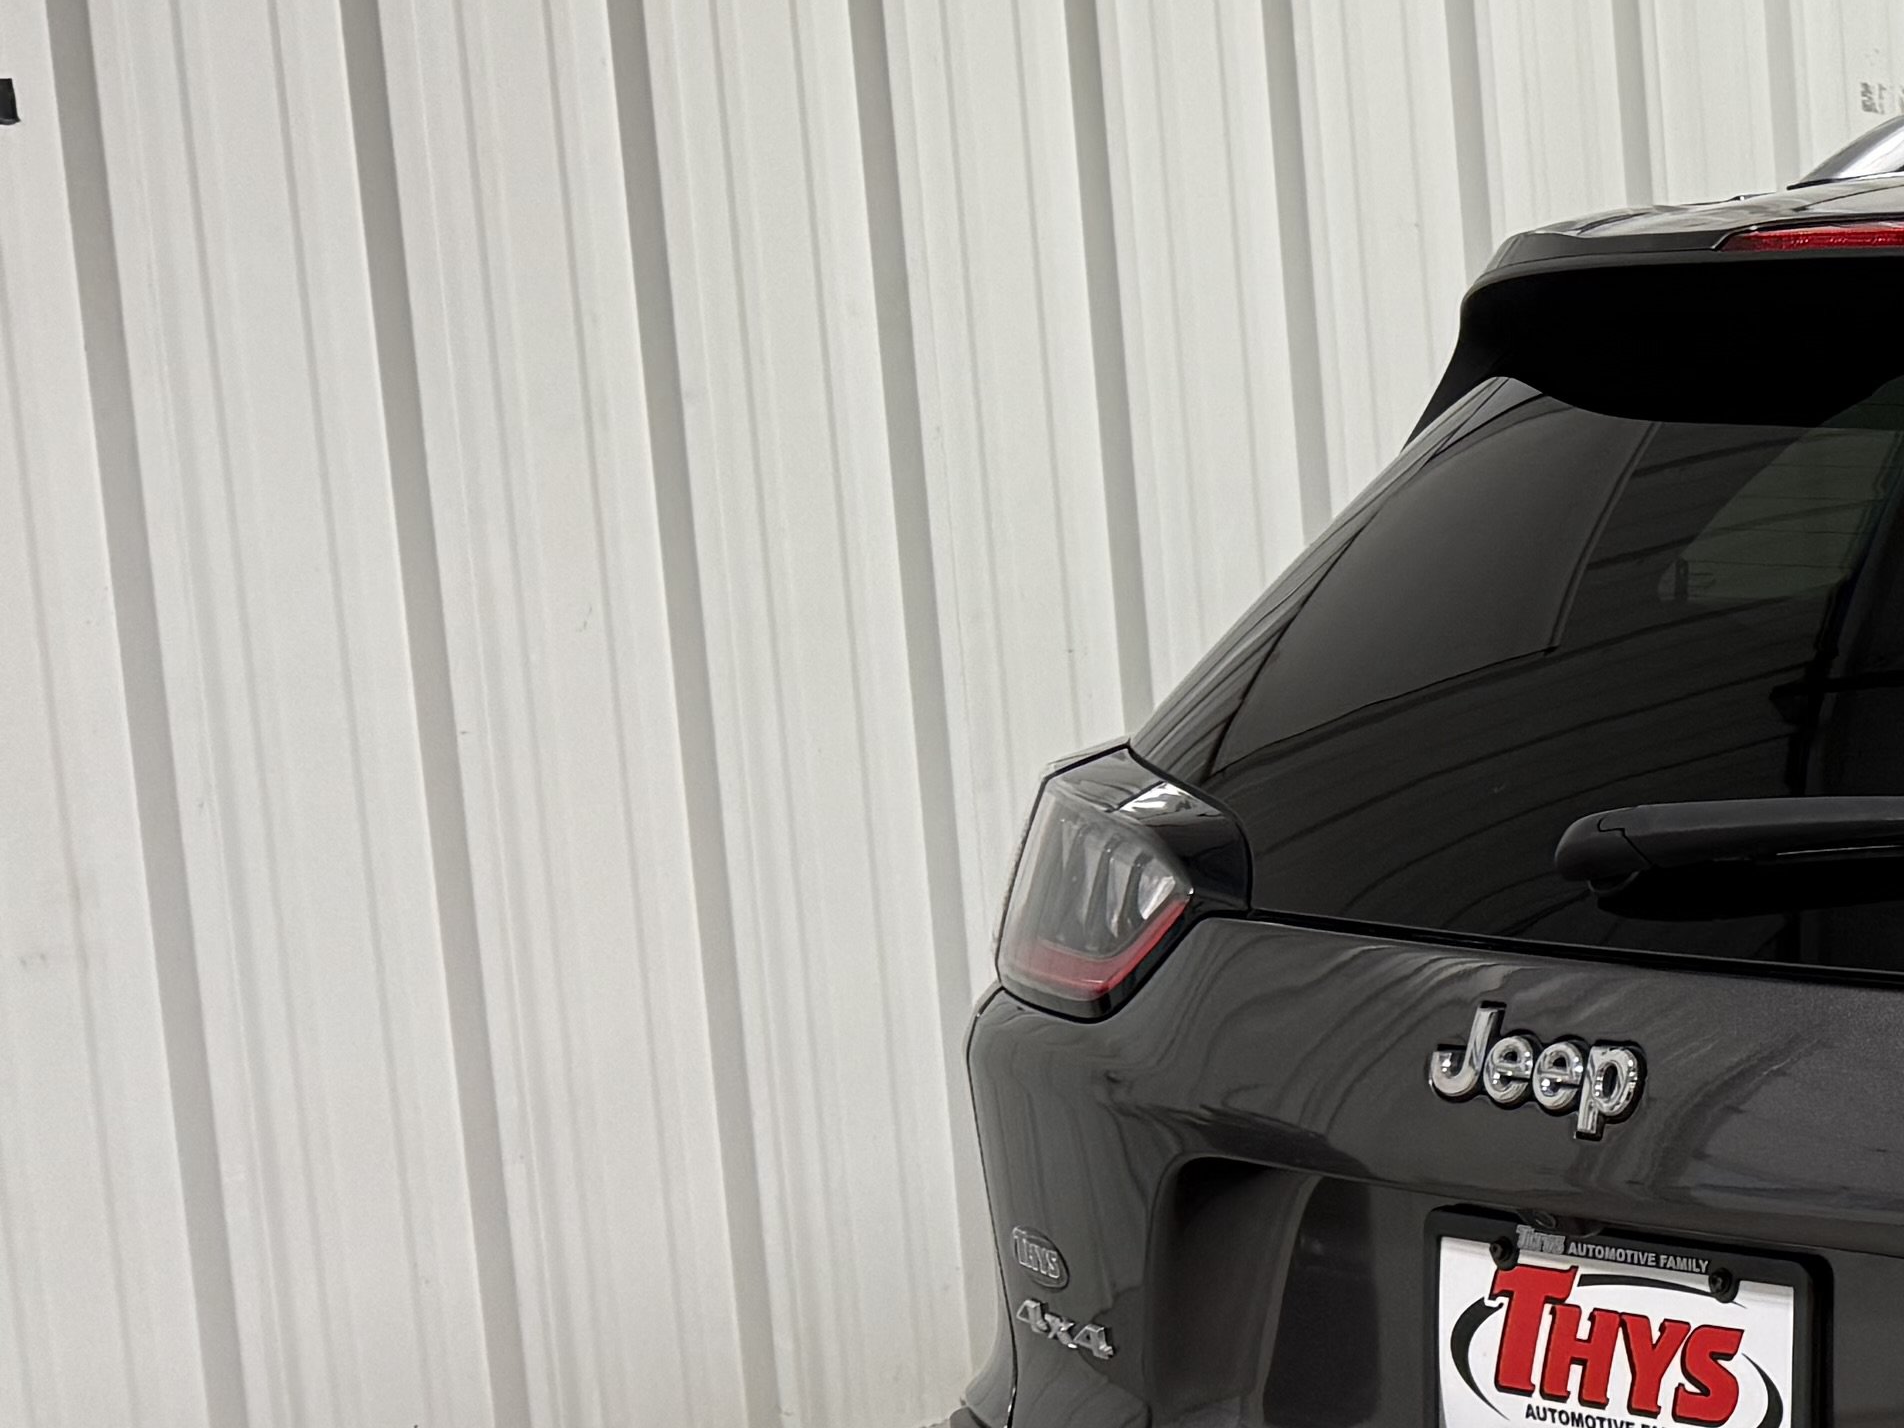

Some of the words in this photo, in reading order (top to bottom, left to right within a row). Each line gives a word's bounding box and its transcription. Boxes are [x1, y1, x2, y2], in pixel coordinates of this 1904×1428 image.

[1429, 1000, 1647, 1141] Jeep
[1568, 1241, 1656, 1266] AUTOMOTIVE
[1659, 1255, 1709, 1273] FAMILY
[1487, 1264, 1745, 1428] THYS
